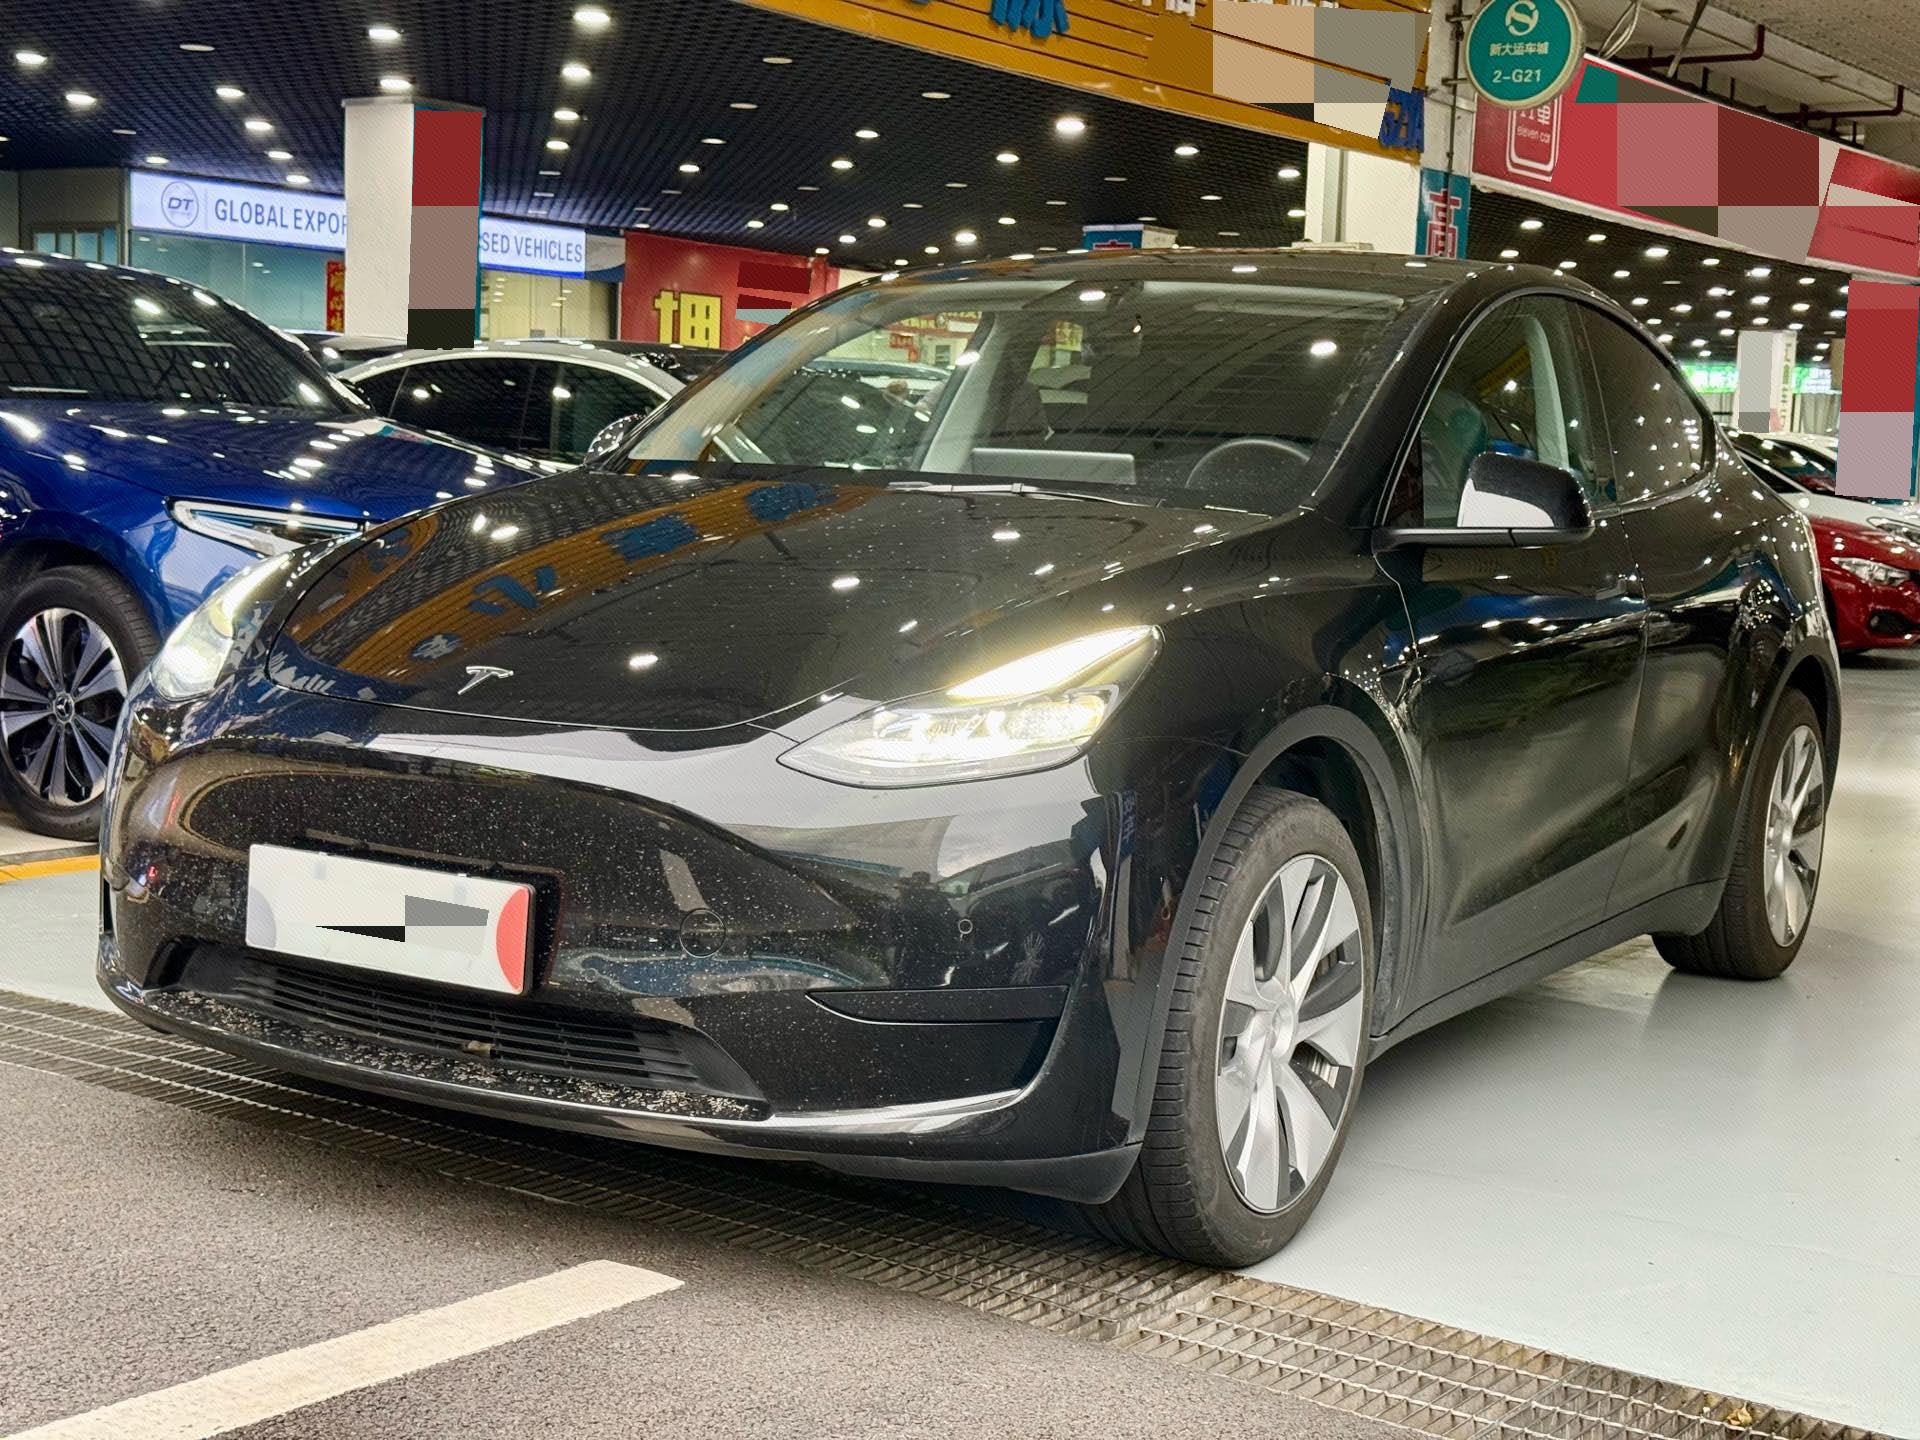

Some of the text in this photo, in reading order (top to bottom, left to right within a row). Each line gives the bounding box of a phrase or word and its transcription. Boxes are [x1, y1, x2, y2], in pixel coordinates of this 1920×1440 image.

[1492, 69, 1541, 83] 2-G21
[168, 197, 194, 211] DT
[214, 198, 288, 228] GLOBAL
[514, 235, 583, 263] VEHICLES
